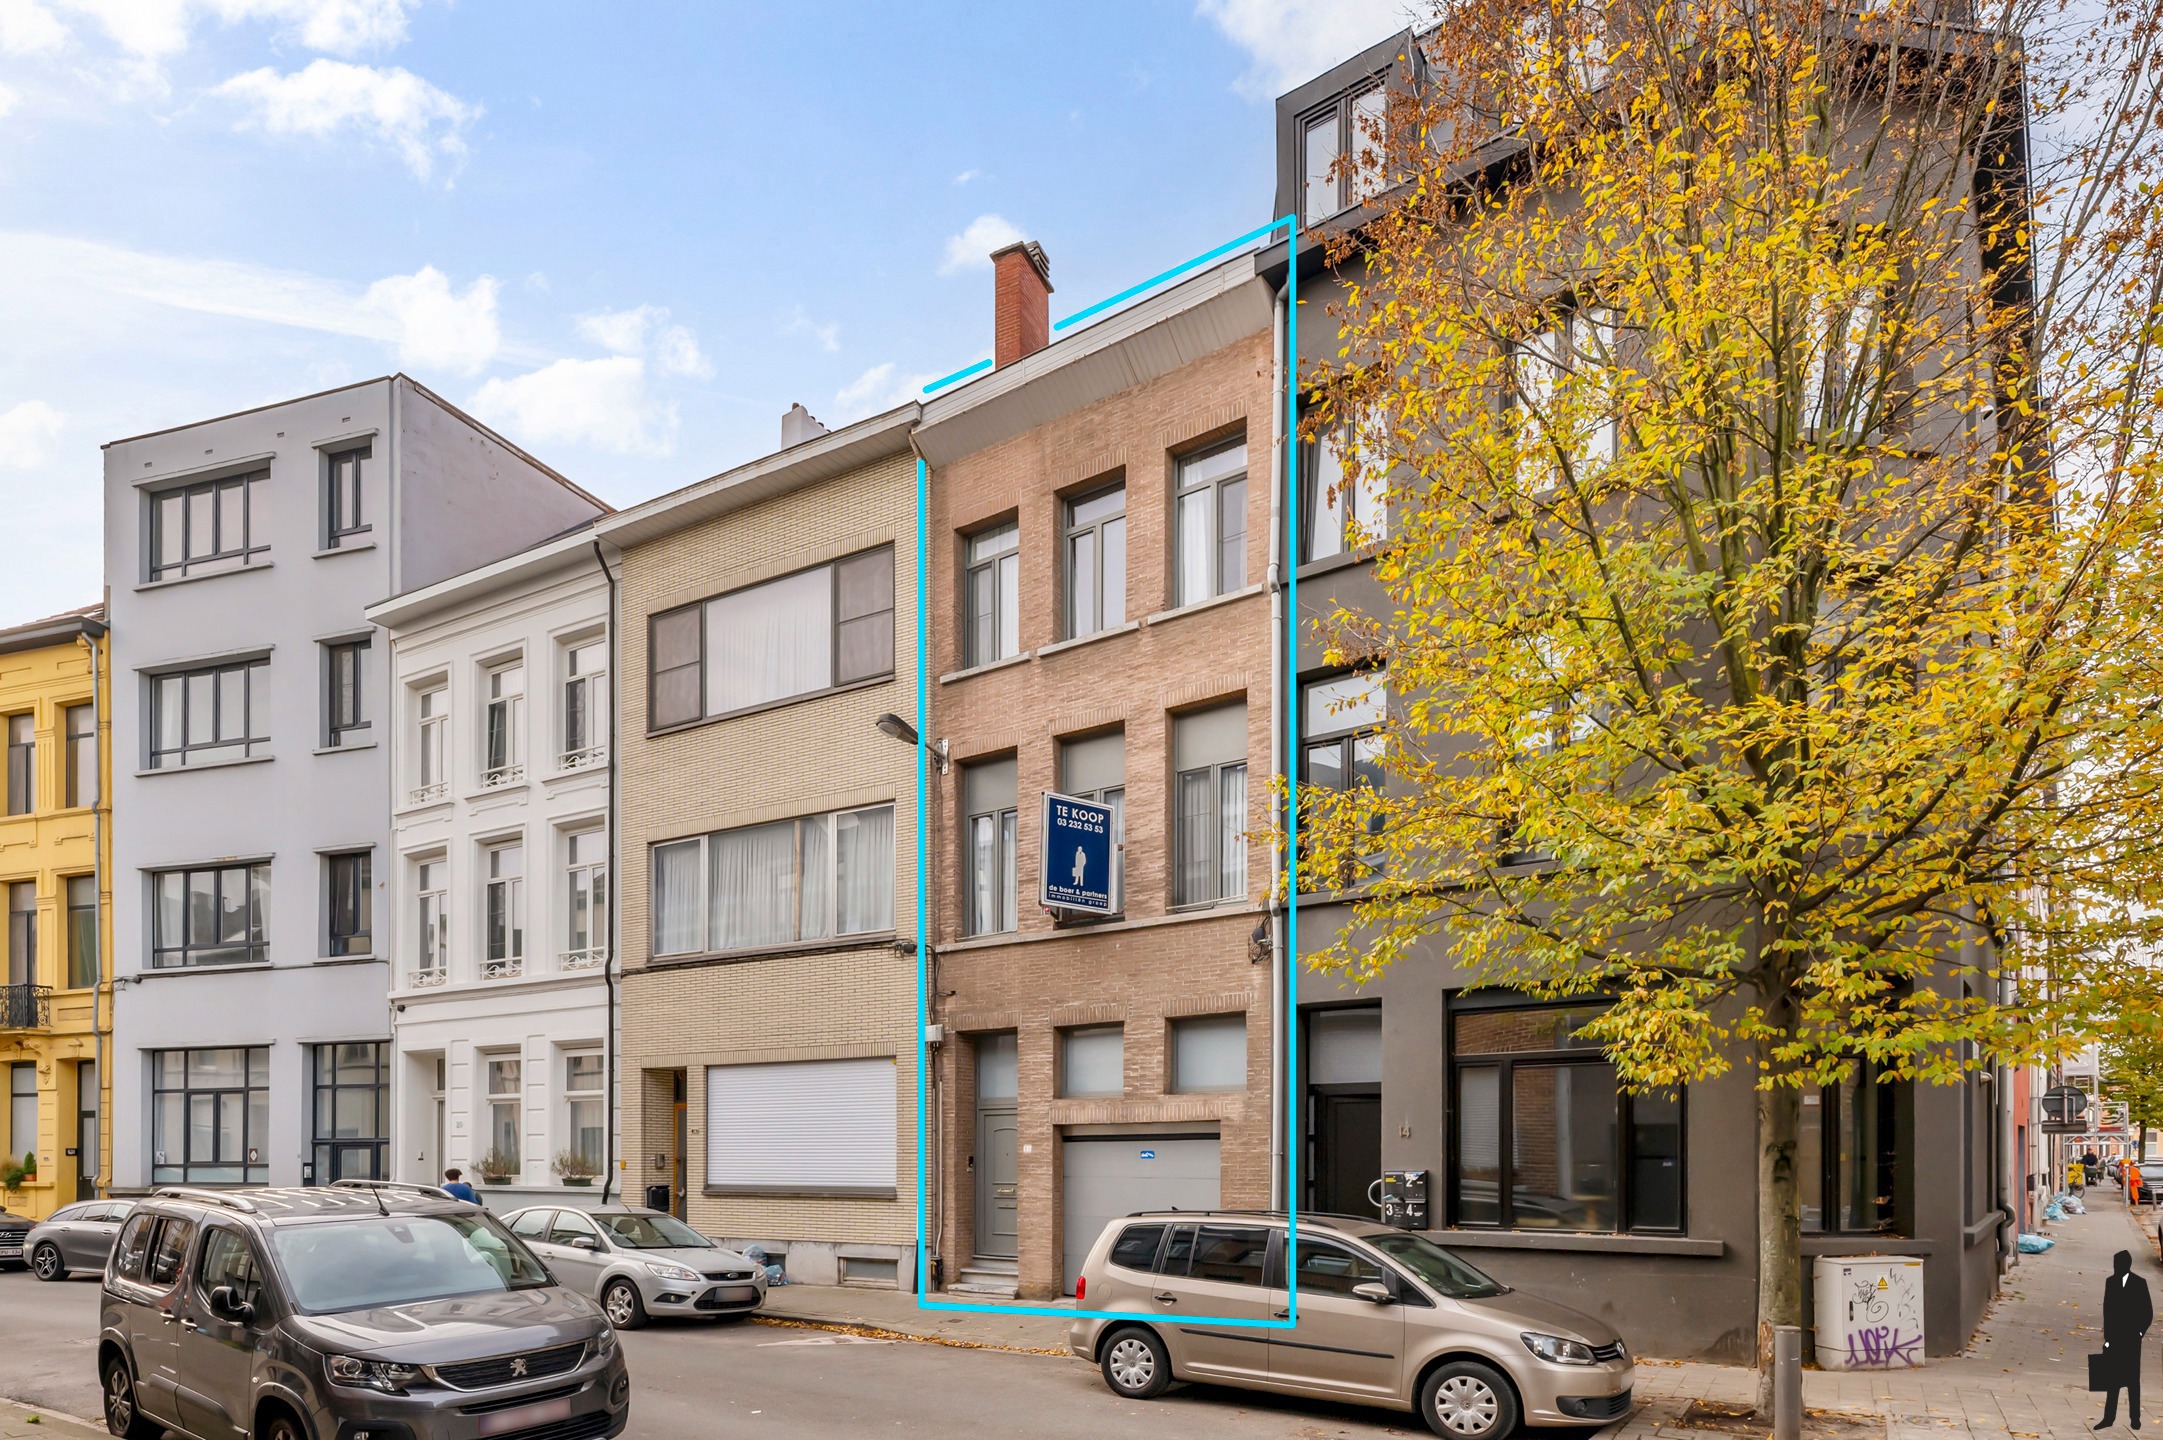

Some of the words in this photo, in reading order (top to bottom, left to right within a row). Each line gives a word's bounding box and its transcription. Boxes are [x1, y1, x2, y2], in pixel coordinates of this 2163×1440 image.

[1056, 805, 1068, 817] TE
[1072, 808, 1104, 824] KOOP
[1057, 818, 1067, 826] 03
[1068, 820, 1082, 830] 232
[1083, 823, 1093, 832] 53
[1094, 825, 1104, 834] 53
[1059, 886, 1074, 894] boer
[1082, 890, 1107, 899] partners
[1399, 1125, 1411, 1138] 14
[1386, 1203, 1393, 1216] 3
[1406, 1203, 1413, 1216] 4
